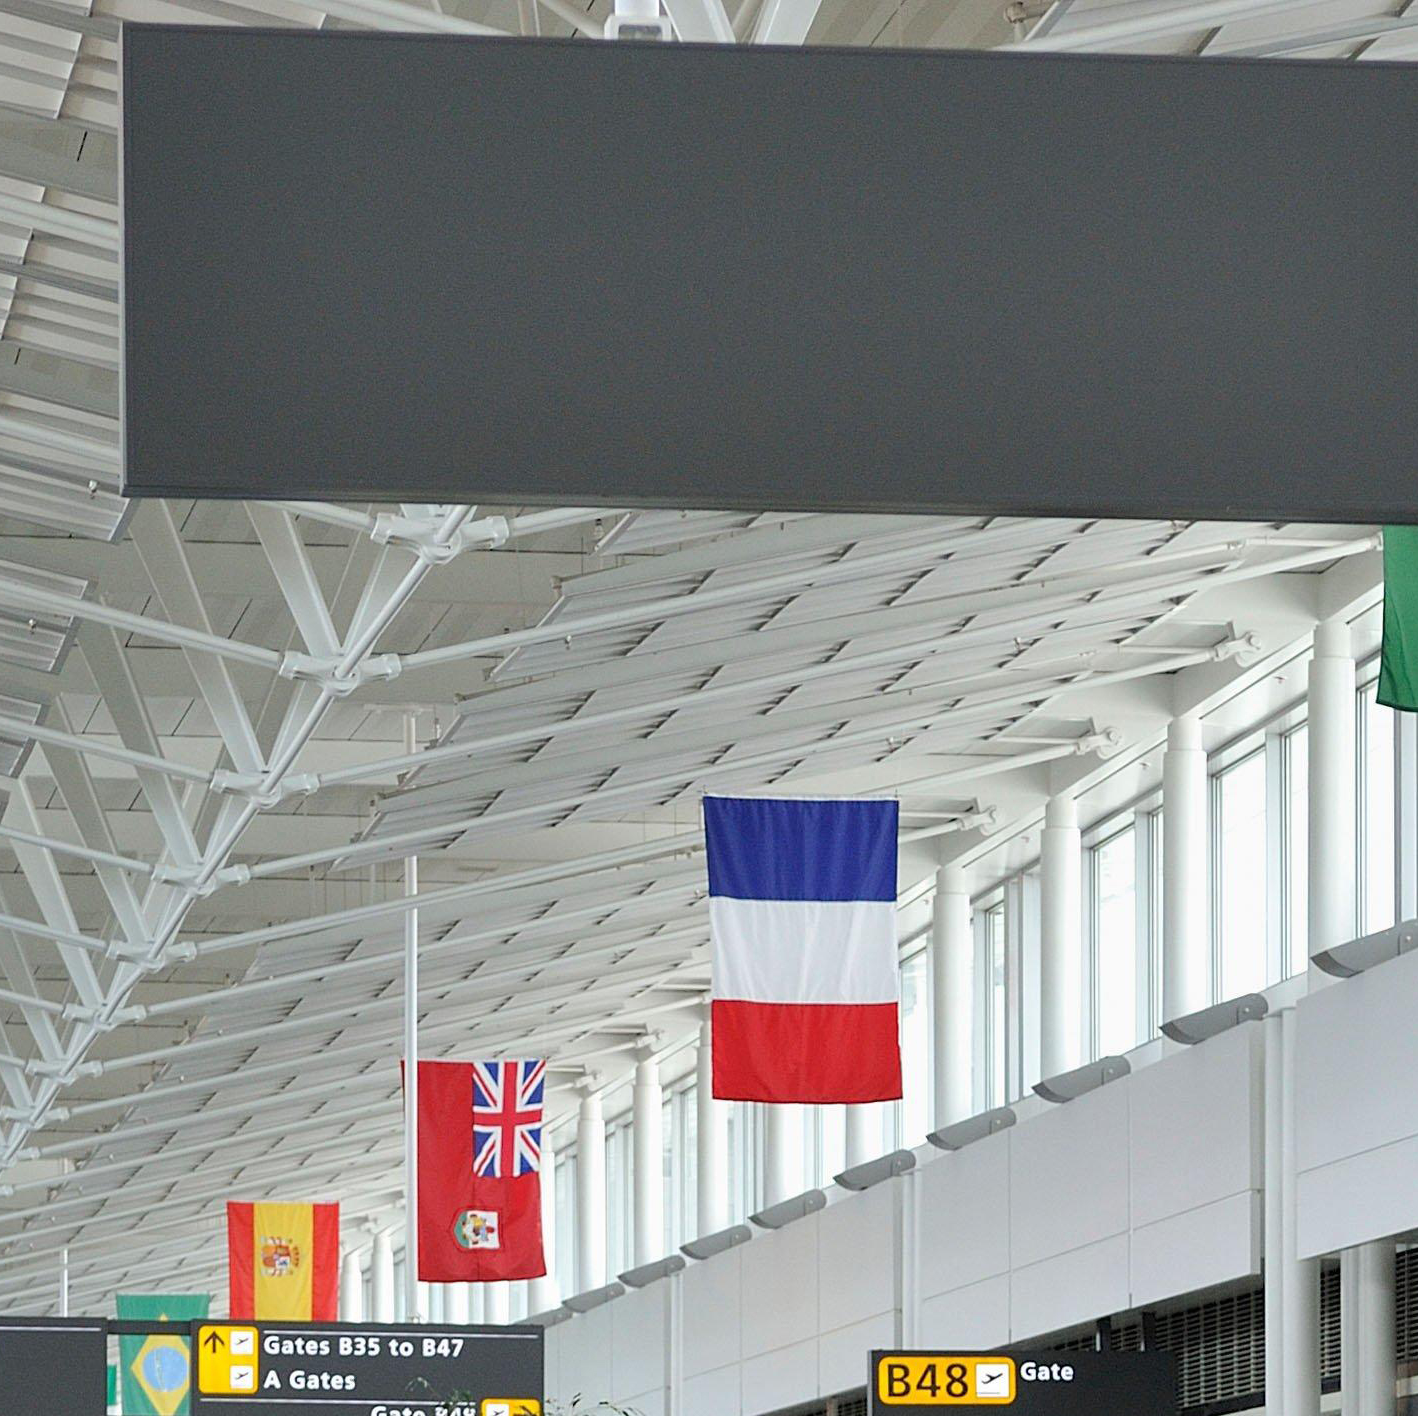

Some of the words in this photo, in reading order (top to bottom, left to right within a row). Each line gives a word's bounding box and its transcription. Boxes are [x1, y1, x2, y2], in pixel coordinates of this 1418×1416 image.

[263, 1335, 331, 1357] Gates
[338, 1336, 381, 1357] B35
[388, 1338, 414, 1358] to
[421, 1337, 465, 1358] B47
[263, 1370, 281, 1390] A
[288, 1369, 357, 1391] Gates
[886, 1362, 970, 1398] B48
[1019, 1361, 1075, 1382] Gate
